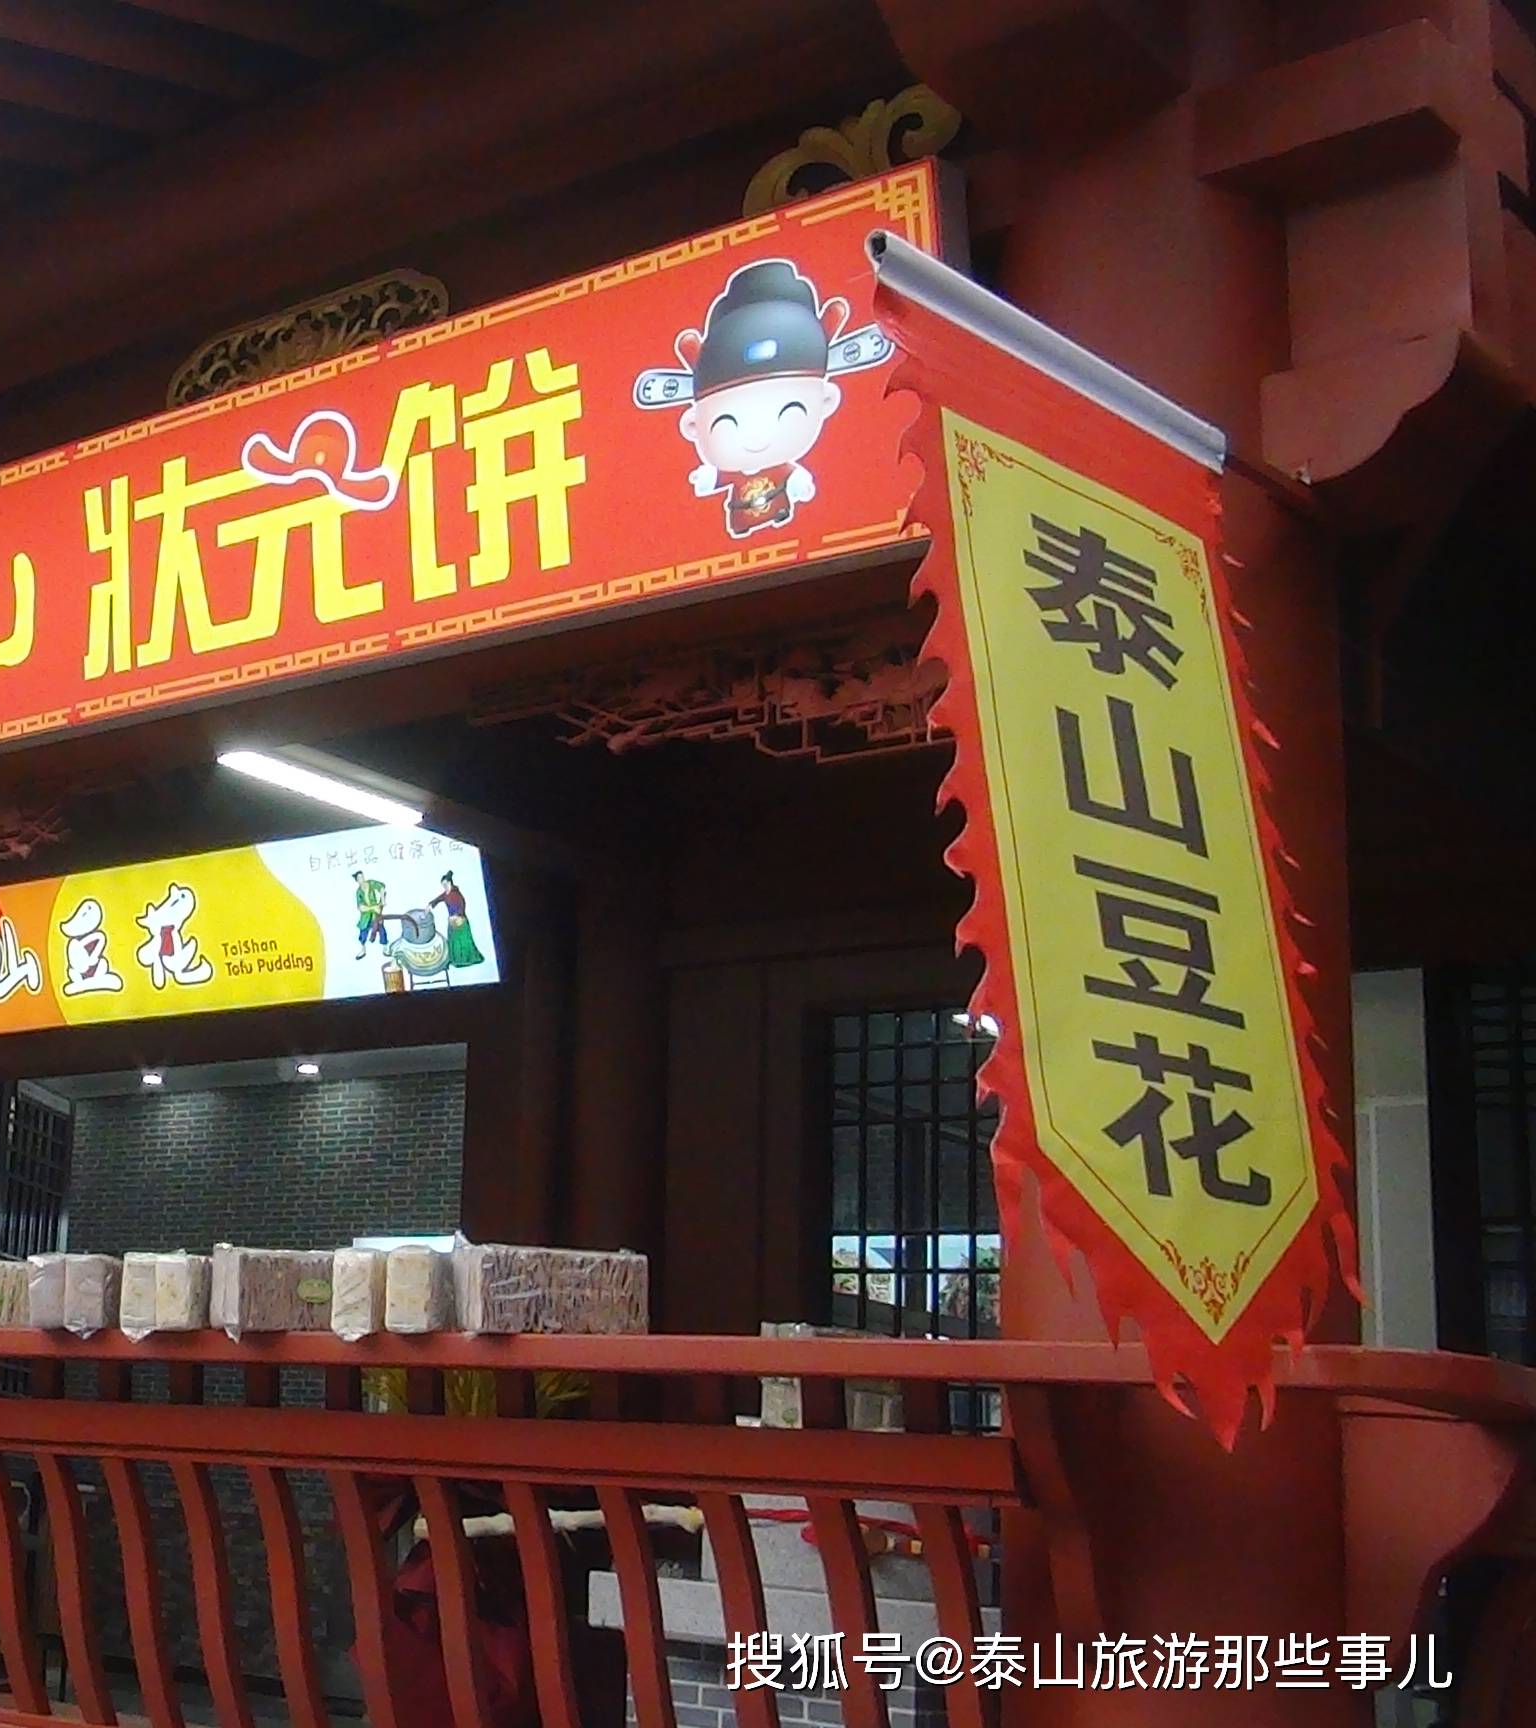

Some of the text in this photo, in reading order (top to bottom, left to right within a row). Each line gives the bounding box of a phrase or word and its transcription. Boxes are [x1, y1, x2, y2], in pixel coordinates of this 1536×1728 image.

[1023, 513, 1272, 1207] 泰山豆花
[221, 939, 278, 957] TaiShan
[225, 953, 313, 976] Tofu Pudding
